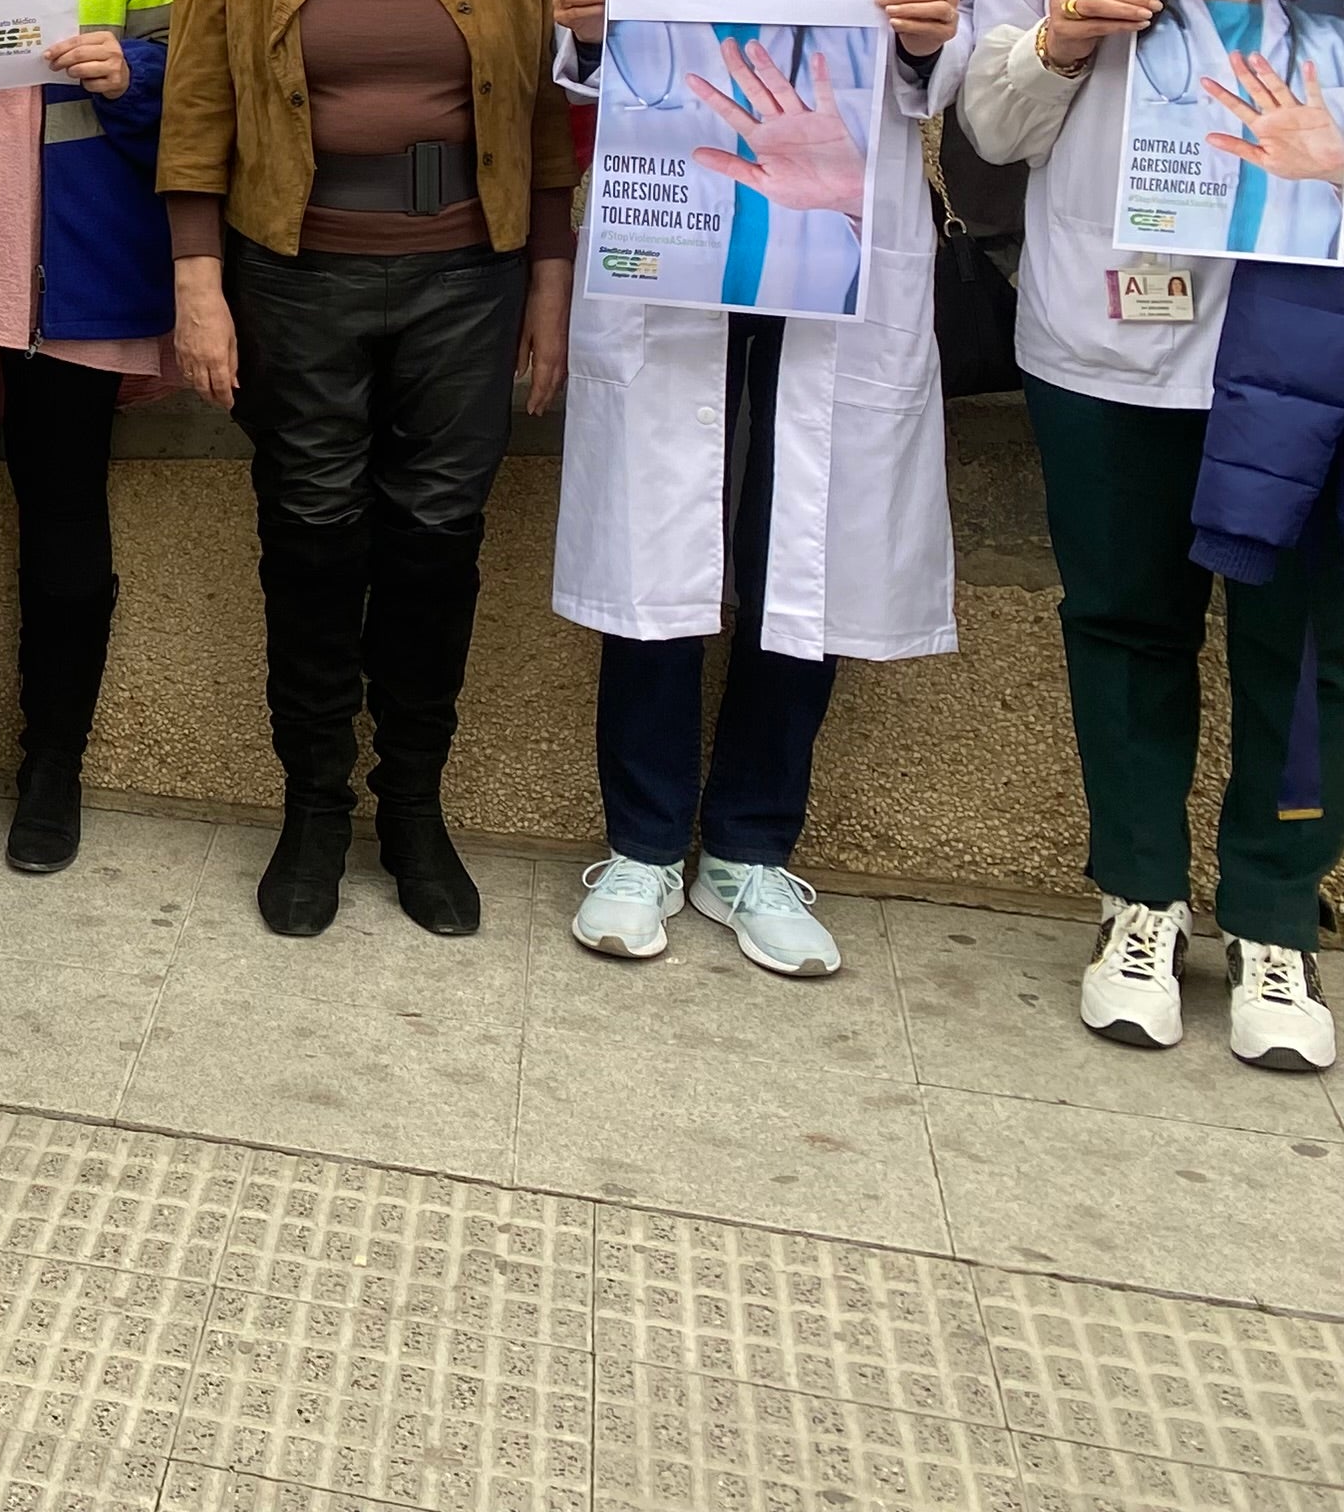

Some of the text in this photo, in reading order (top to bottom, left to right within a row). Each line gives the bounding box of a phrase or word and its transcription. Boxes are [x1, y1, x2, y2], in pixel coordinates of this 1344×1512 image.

[1133, 138, 1200, 156] CONTRA LAS
[604, 155, 686, 177] CONTRA LAS
[1131, 157, 1202, 175] AGRESIONES
[602, 181, 689, 204] AGRESIONES
[1130, 177, 1227, 196] TOLERANCIA CERO
[601, 206, 721, 232] TOLERANCIA CERO
